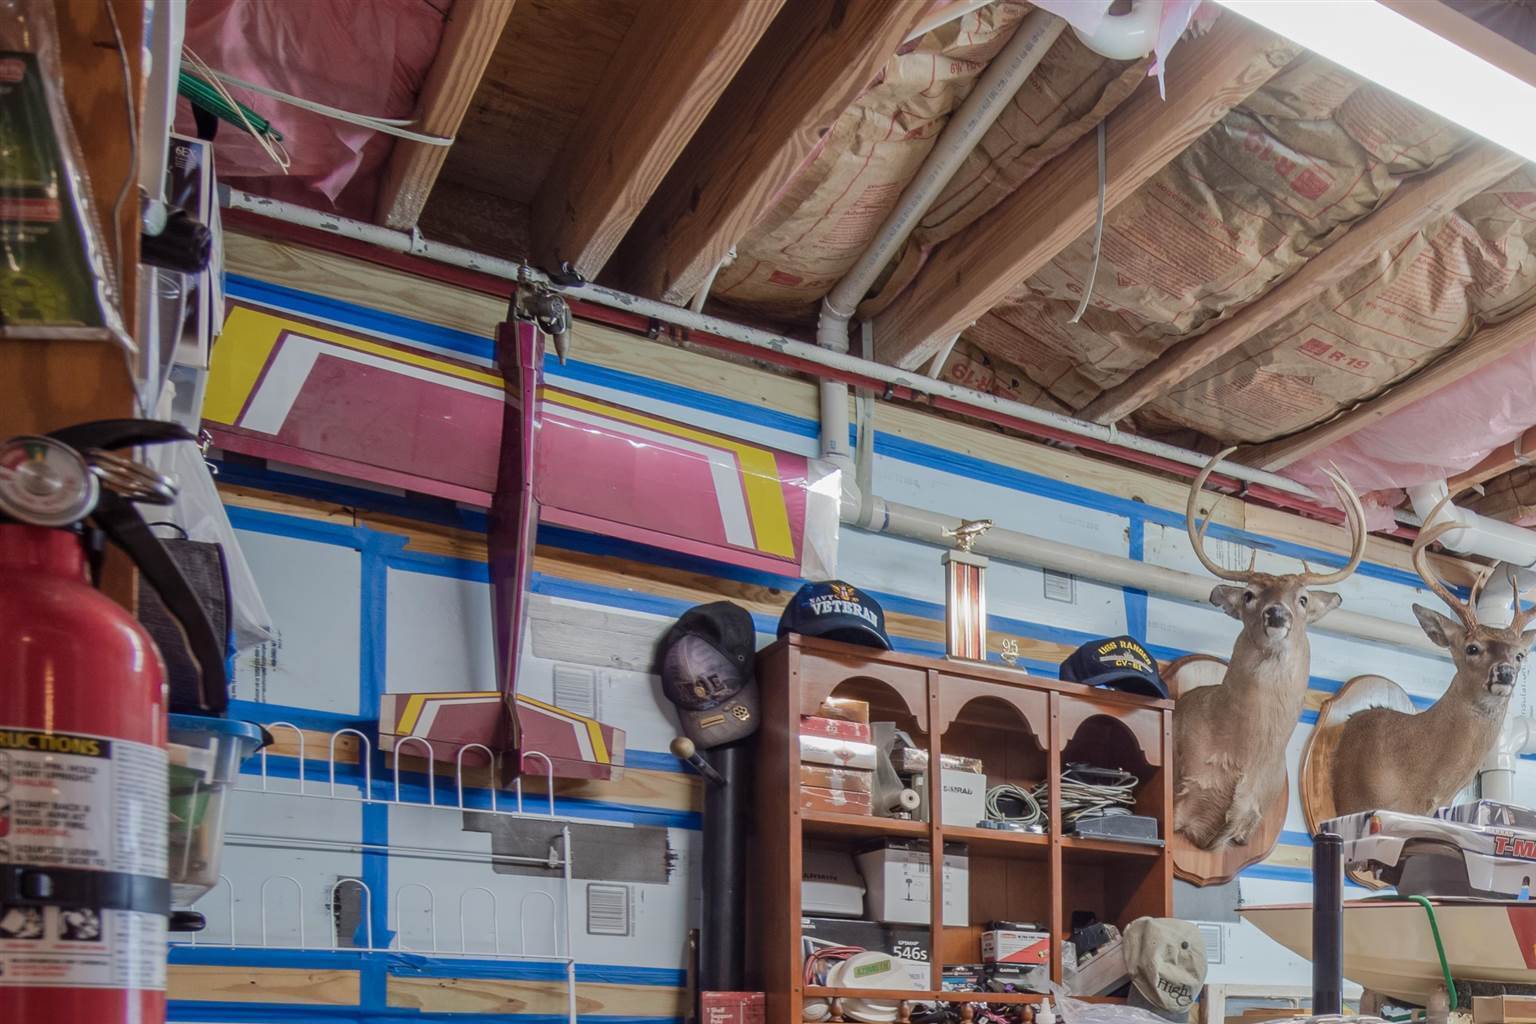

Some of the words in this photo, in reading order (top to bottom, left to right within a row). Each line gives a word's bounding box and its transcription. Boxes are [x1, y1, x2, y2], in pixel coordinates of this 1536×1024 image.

[1328, 350, 1371, 370] R-19
[808, 594, 835, 605] NAVY
[810, 599, 878, 628] VETERAN
[1001, 638, 1019, 654] 95
[1098, 640, 1118, 656] USS
[1119, 639, 1153, 667] RANGER
[892, 945, 928, 961] 546s
